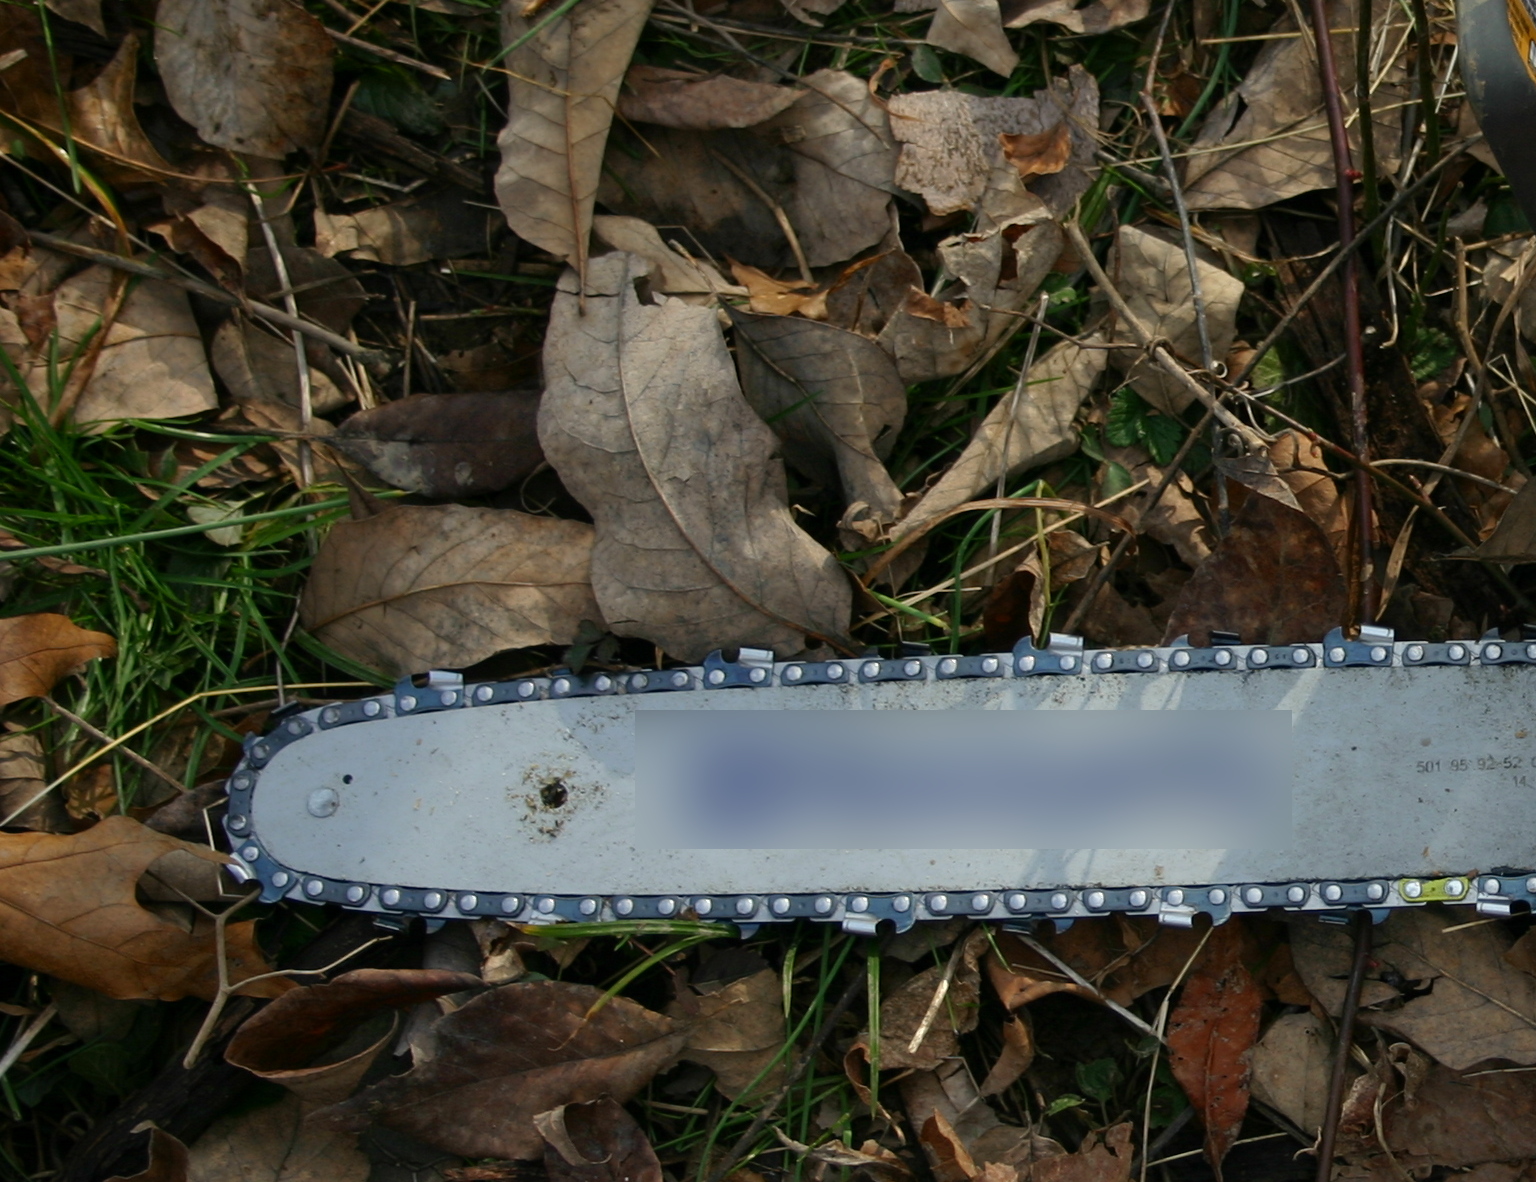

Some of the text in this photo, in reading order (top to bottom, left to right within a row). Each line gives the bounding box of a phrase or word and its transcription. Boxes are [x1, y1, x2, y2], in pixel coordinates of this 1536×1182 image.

[1416, 759, 1441, 774] 501
[1450, 758, 1468, 772] 95
[1513, 775, 1527, 787] 14
